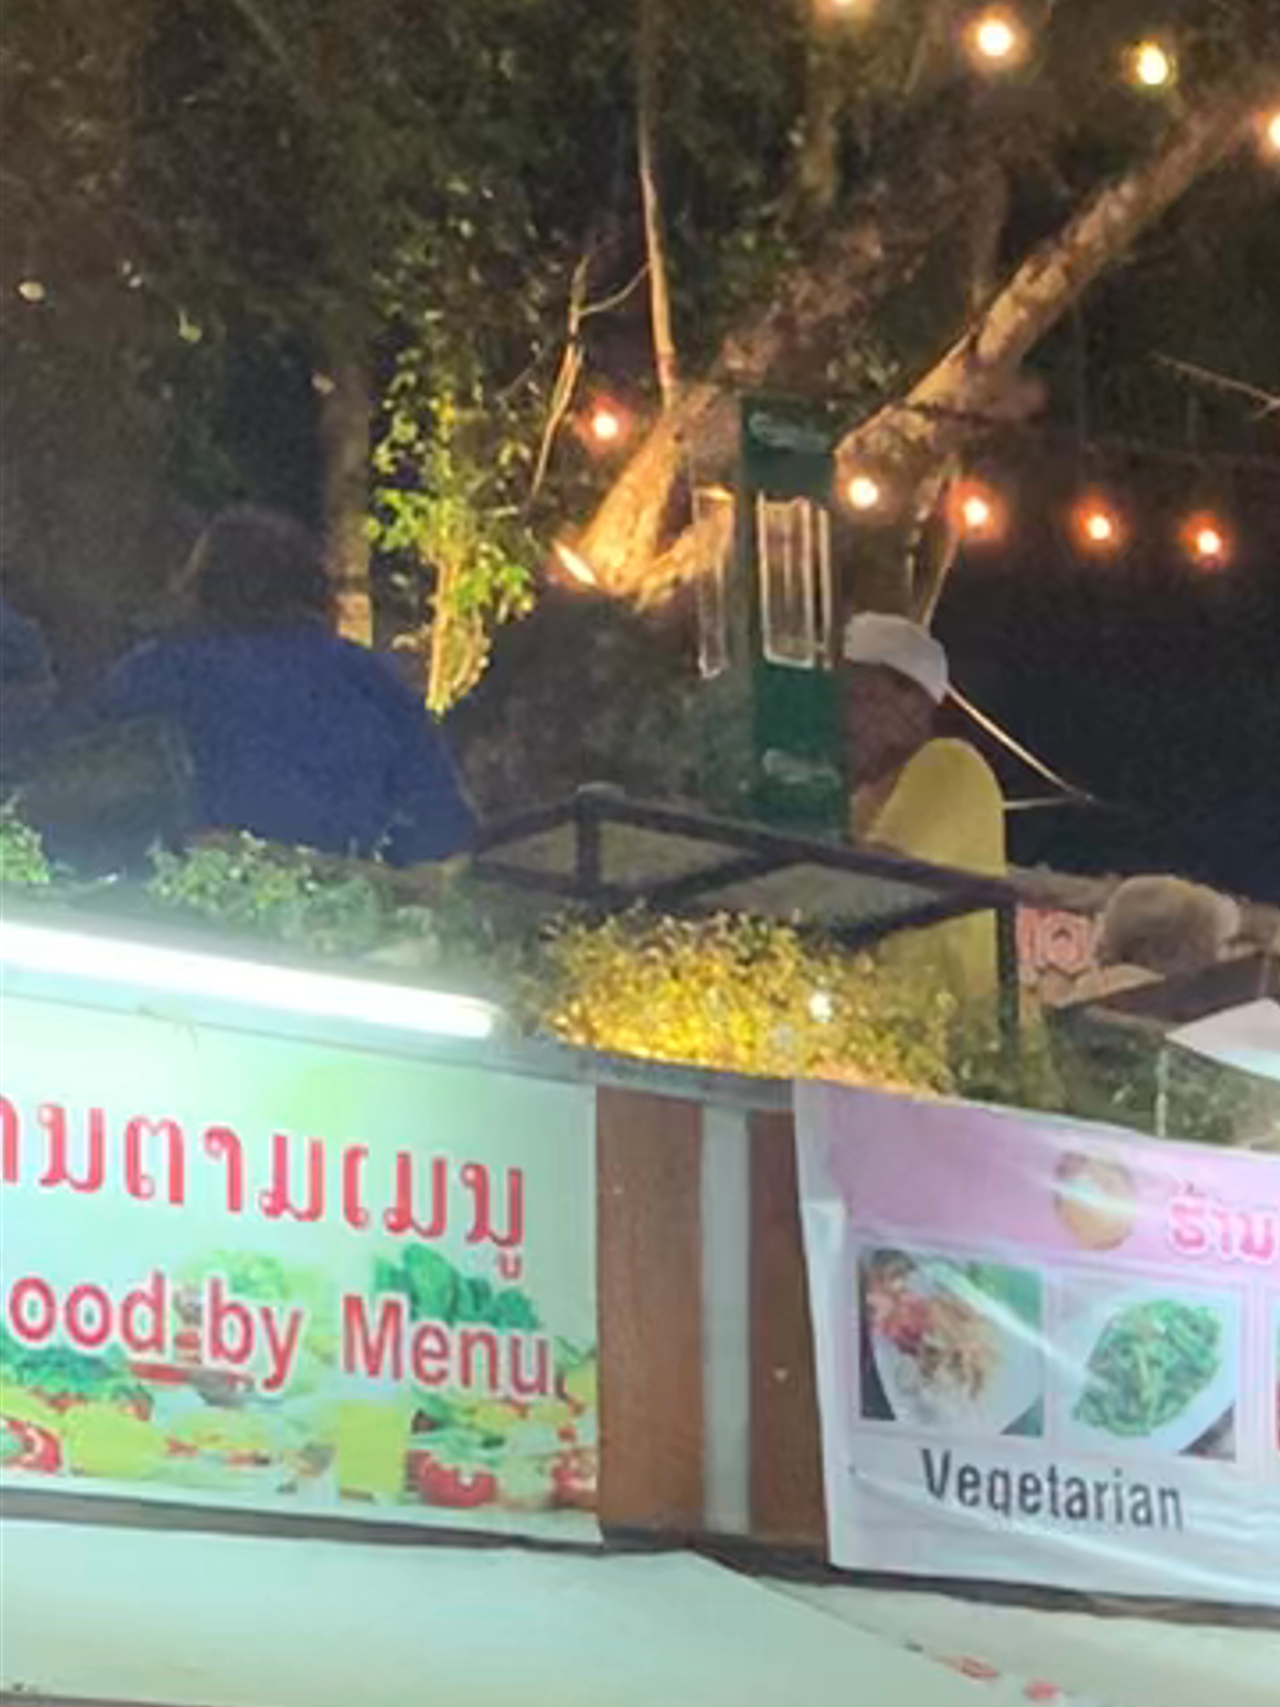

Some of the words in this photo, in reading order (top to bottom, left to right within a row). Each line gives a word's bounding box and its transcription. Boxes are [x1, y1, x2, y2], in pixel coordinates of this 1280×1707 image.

[208, 1278, 303, 1392] by
[342, 1294, 549, 1394] Menu
[920, 1447, 1183, 1531] Vegetarian
